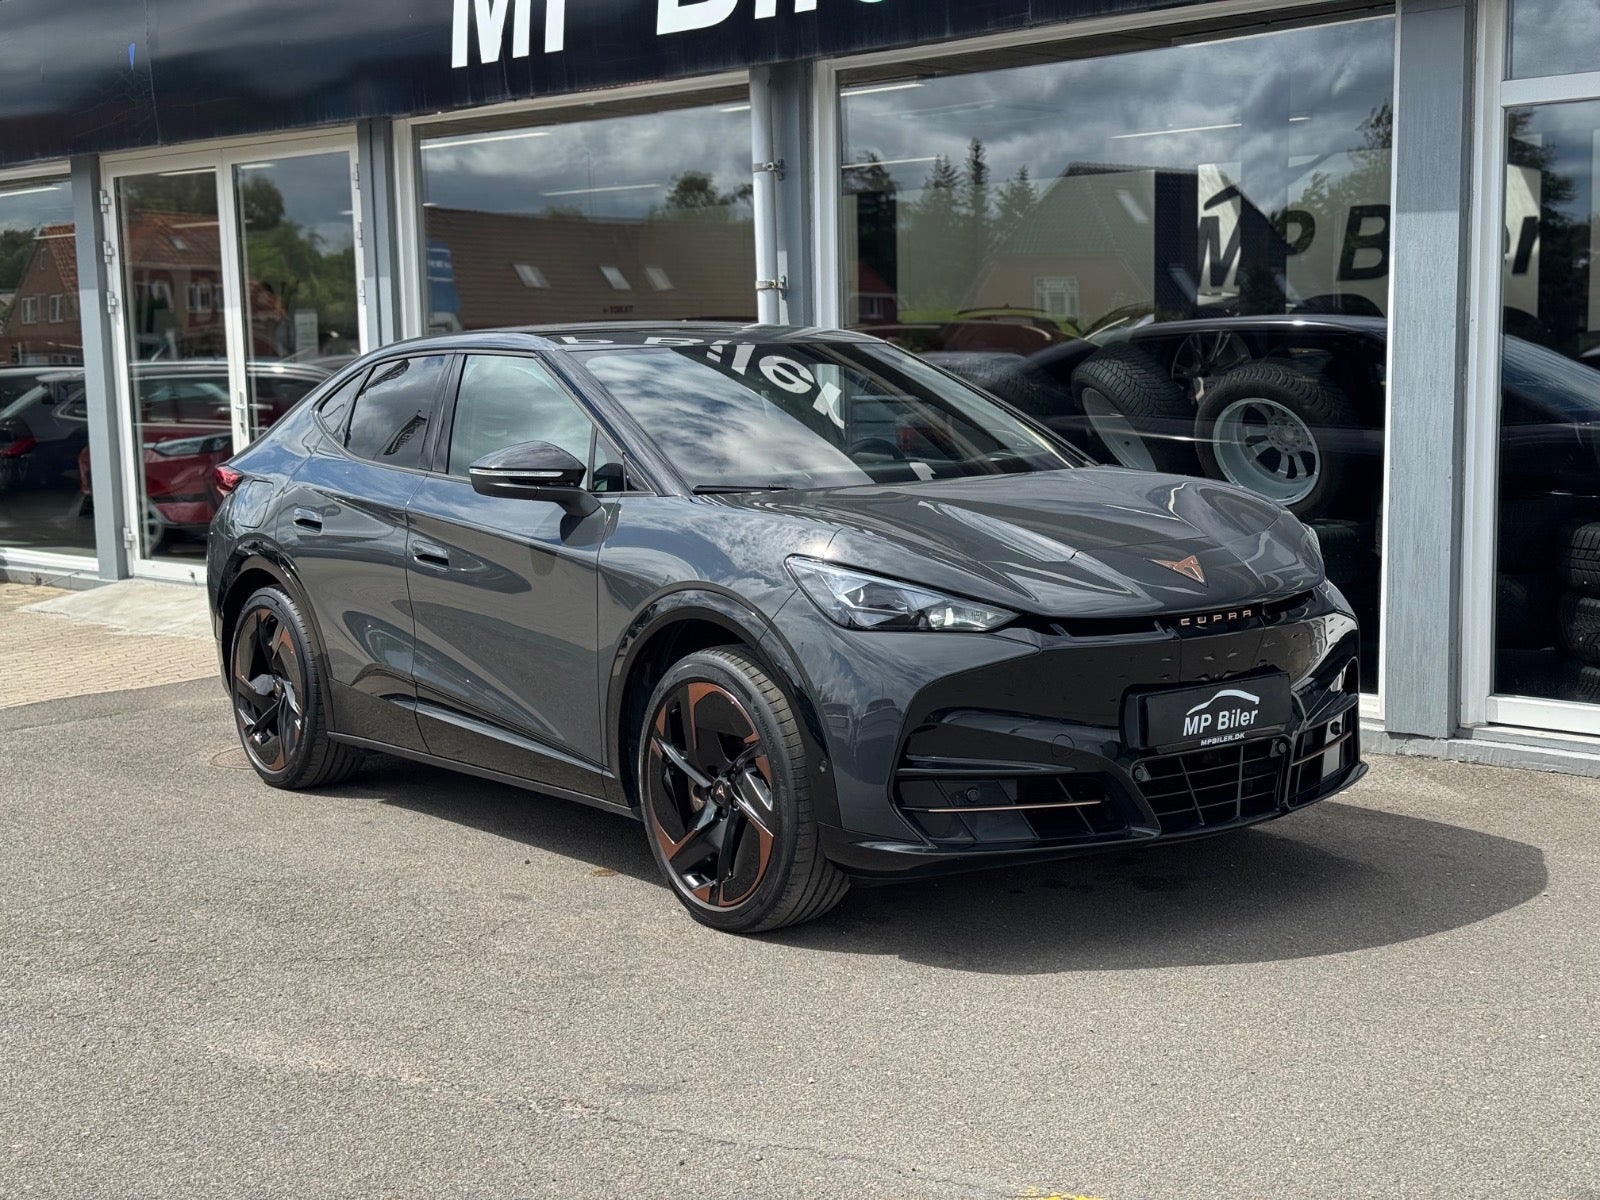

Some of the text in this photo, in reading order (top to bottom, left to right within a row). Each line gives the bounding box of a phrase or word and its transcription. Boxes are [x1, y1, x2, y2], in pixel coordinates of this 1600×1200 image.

[1180, 609, 1252, 626] CUPRA
[1183, 708, 1259, 737] MP Biler
[1200, 731, 1246, 746] MPBILER.DK
